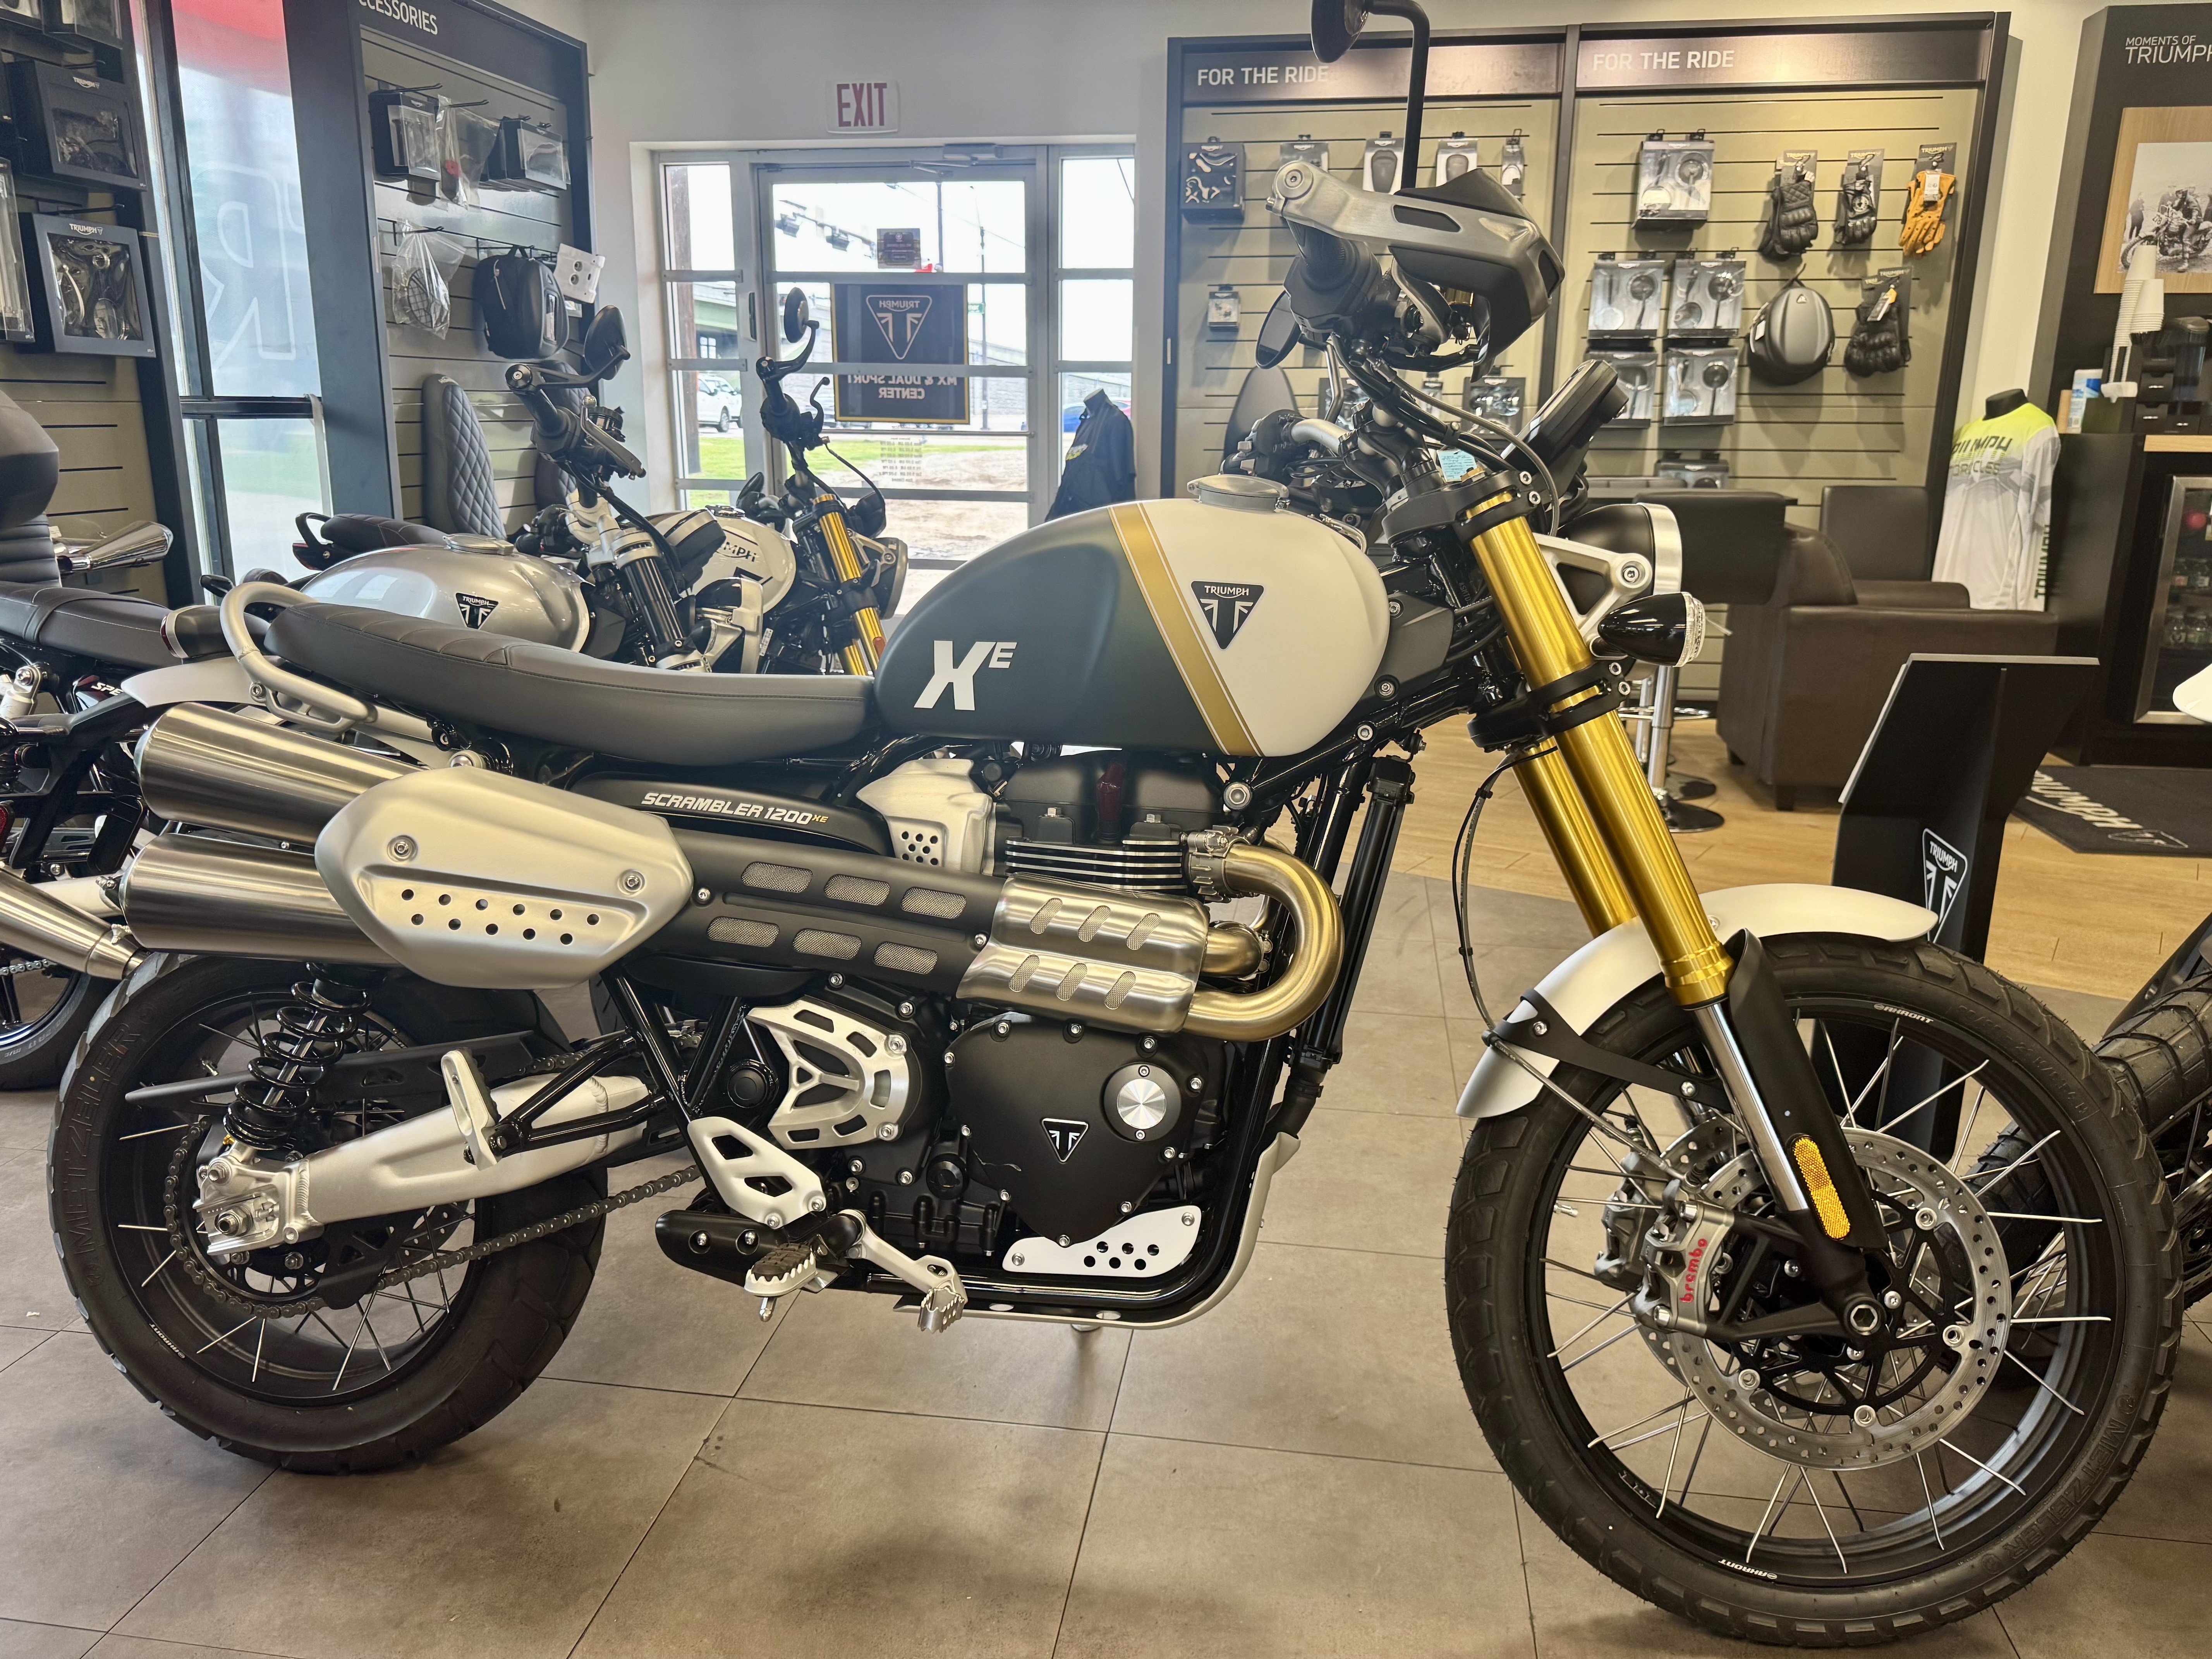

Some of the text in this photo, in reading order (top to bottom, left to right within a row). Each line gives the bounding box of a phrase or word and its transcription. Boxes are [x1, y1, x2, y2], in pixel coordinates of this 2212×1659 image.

[2125, 35, 2196, 46] MOMENTS OF
[1593, 50, 1735, 70] FOR THE RIDE
[1198, 65, 1329, 86] FOR THE RIDE
[836, 82, 887, 127] EXIT
[69, 223, 97, 235] TRIUMPH
[463, 596, 489, 606] TRIUMPH
[1204, 585, 1249, 599] TRIUMPH
[641, 792, 829, 825] SCRAMBLER 1200 XE
[1930, 841, 1958, 873] TRIUMPH
[1680, 1238, 1708, 1303] brembo
